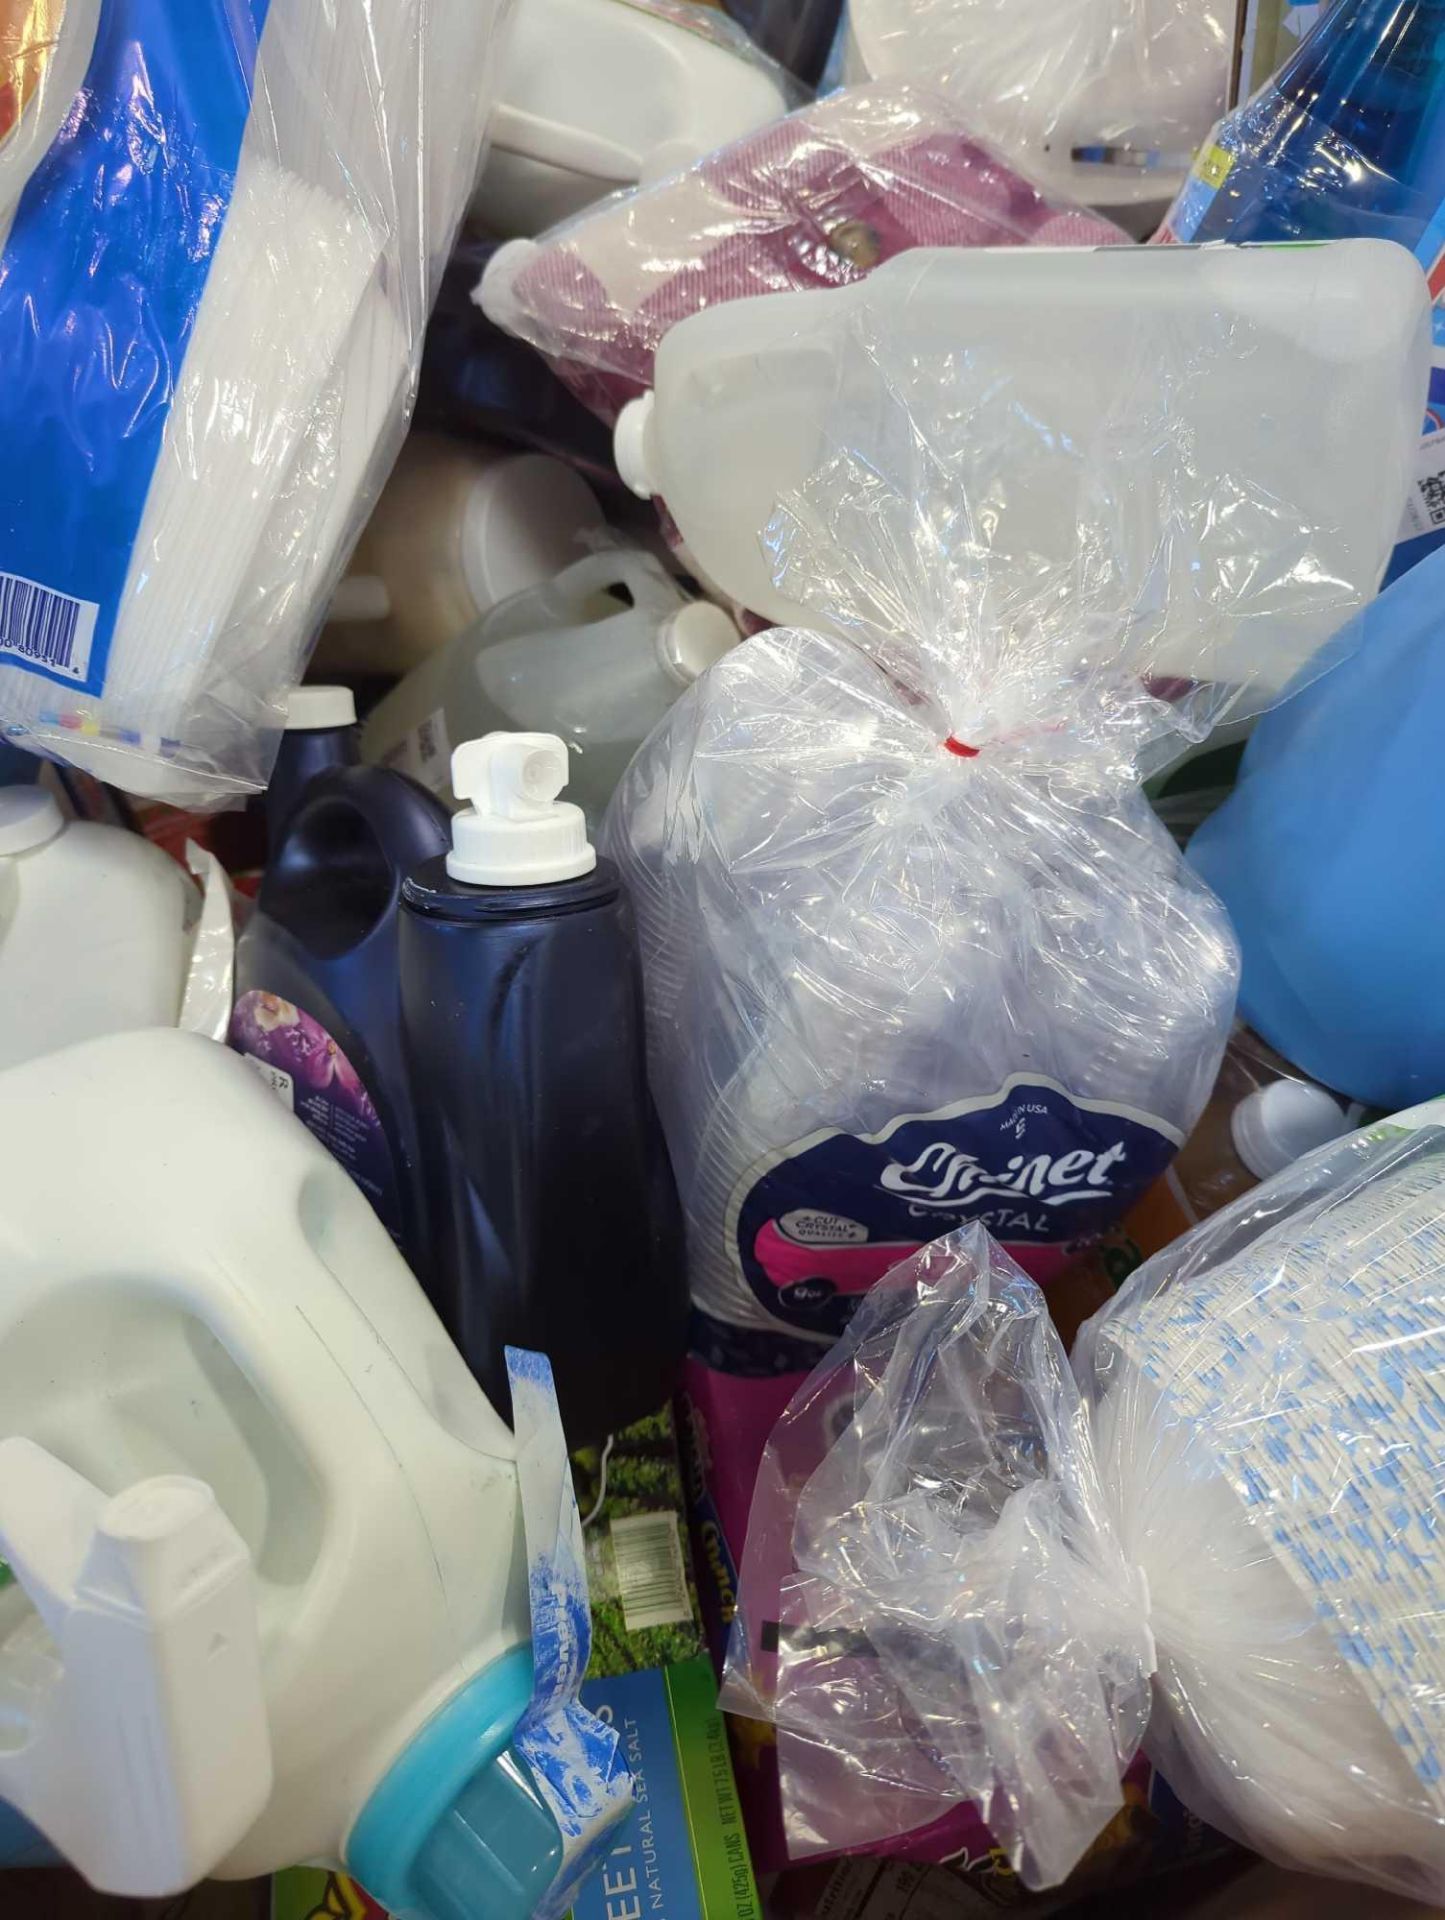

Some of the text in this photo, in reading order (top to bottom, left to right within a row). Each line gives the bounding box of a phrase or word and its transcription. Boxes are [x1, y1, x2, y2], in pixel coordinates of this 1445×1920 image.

[1026, 1103, 1048, 1114] USA
[624, 1717, 642, 1764] SALT
[638, 1809, 664, 1910] NATURAL
[724, 1832, 744, 1862] CANS
